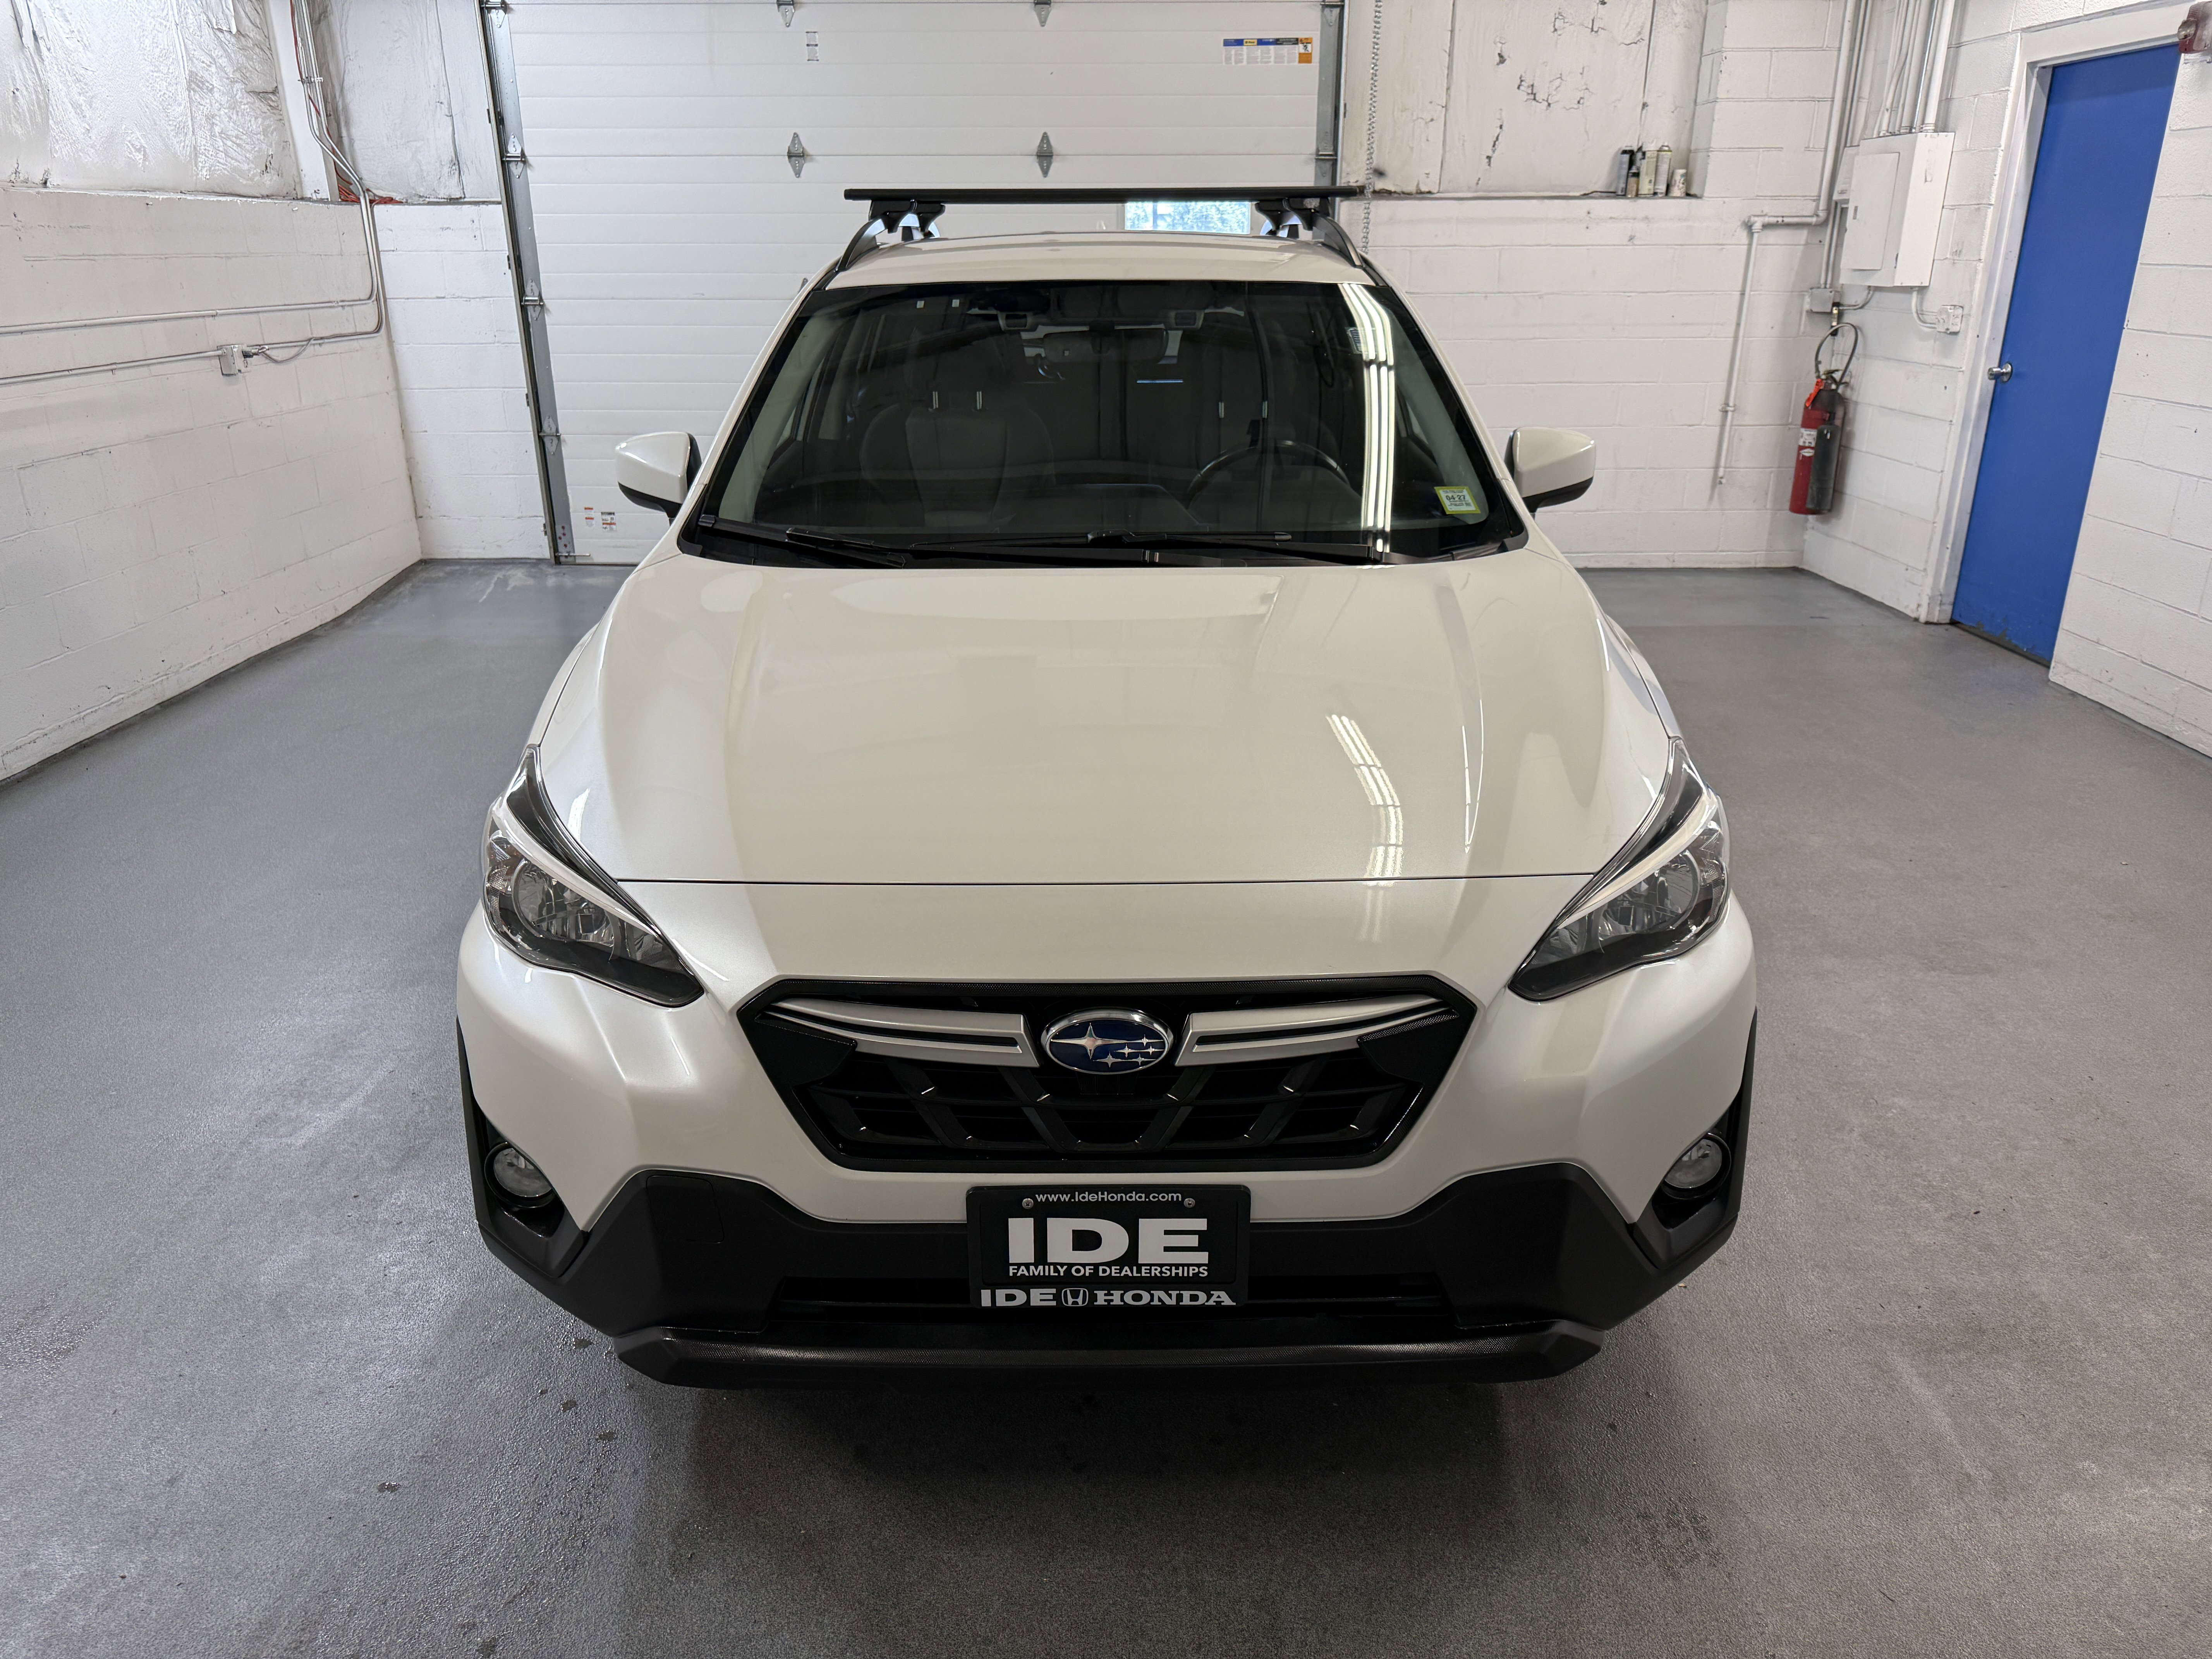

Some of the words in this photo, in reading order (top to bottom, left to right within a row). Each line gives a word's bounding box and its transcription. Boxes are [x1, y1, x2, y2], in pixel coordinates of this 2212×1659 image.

[1036, 1191, 1182, 1202] www.IdeHonda.com
[1008, 1218, 1209, 1264] IDE
[1009, 1266, 1068, 1276] FAMILY
[1072, 1266, 1094, 1276] OF
[1099, 1266, 1208, 1277] DEALERSHIPS
[981, 1289, 1056, 1307] IDE
[1094, 1290, 1236, 1305] HONDA
